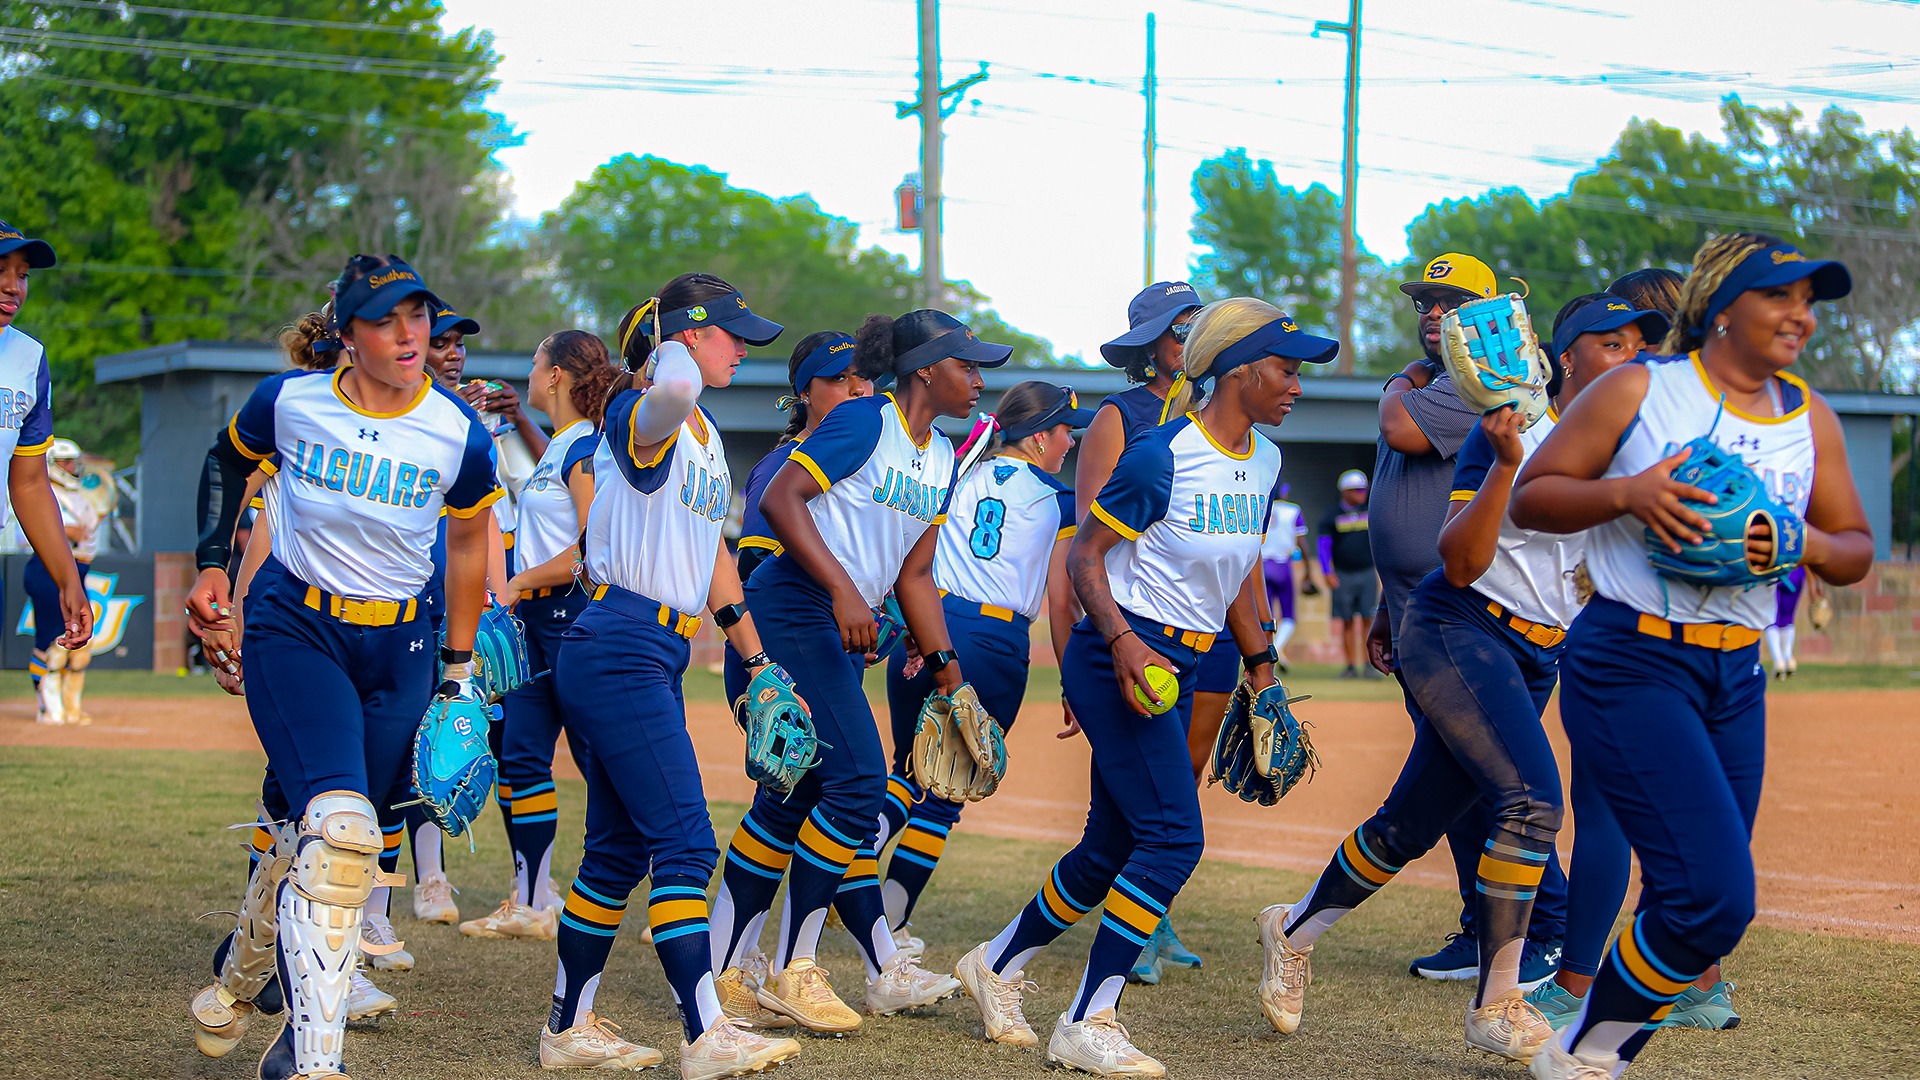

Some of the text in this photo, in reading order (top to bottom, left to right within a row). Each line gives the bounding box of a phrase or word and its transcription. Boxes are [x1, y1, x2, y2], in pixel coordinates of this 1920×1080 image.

[368, 269, 416, 289] Southern
[1427, 260, 1456, 279] SU
[293, 439, 442, 508] JAGUARS
[968, 496, 1007, 561] 8
[1274, 732, 1284, 755] ASIA
